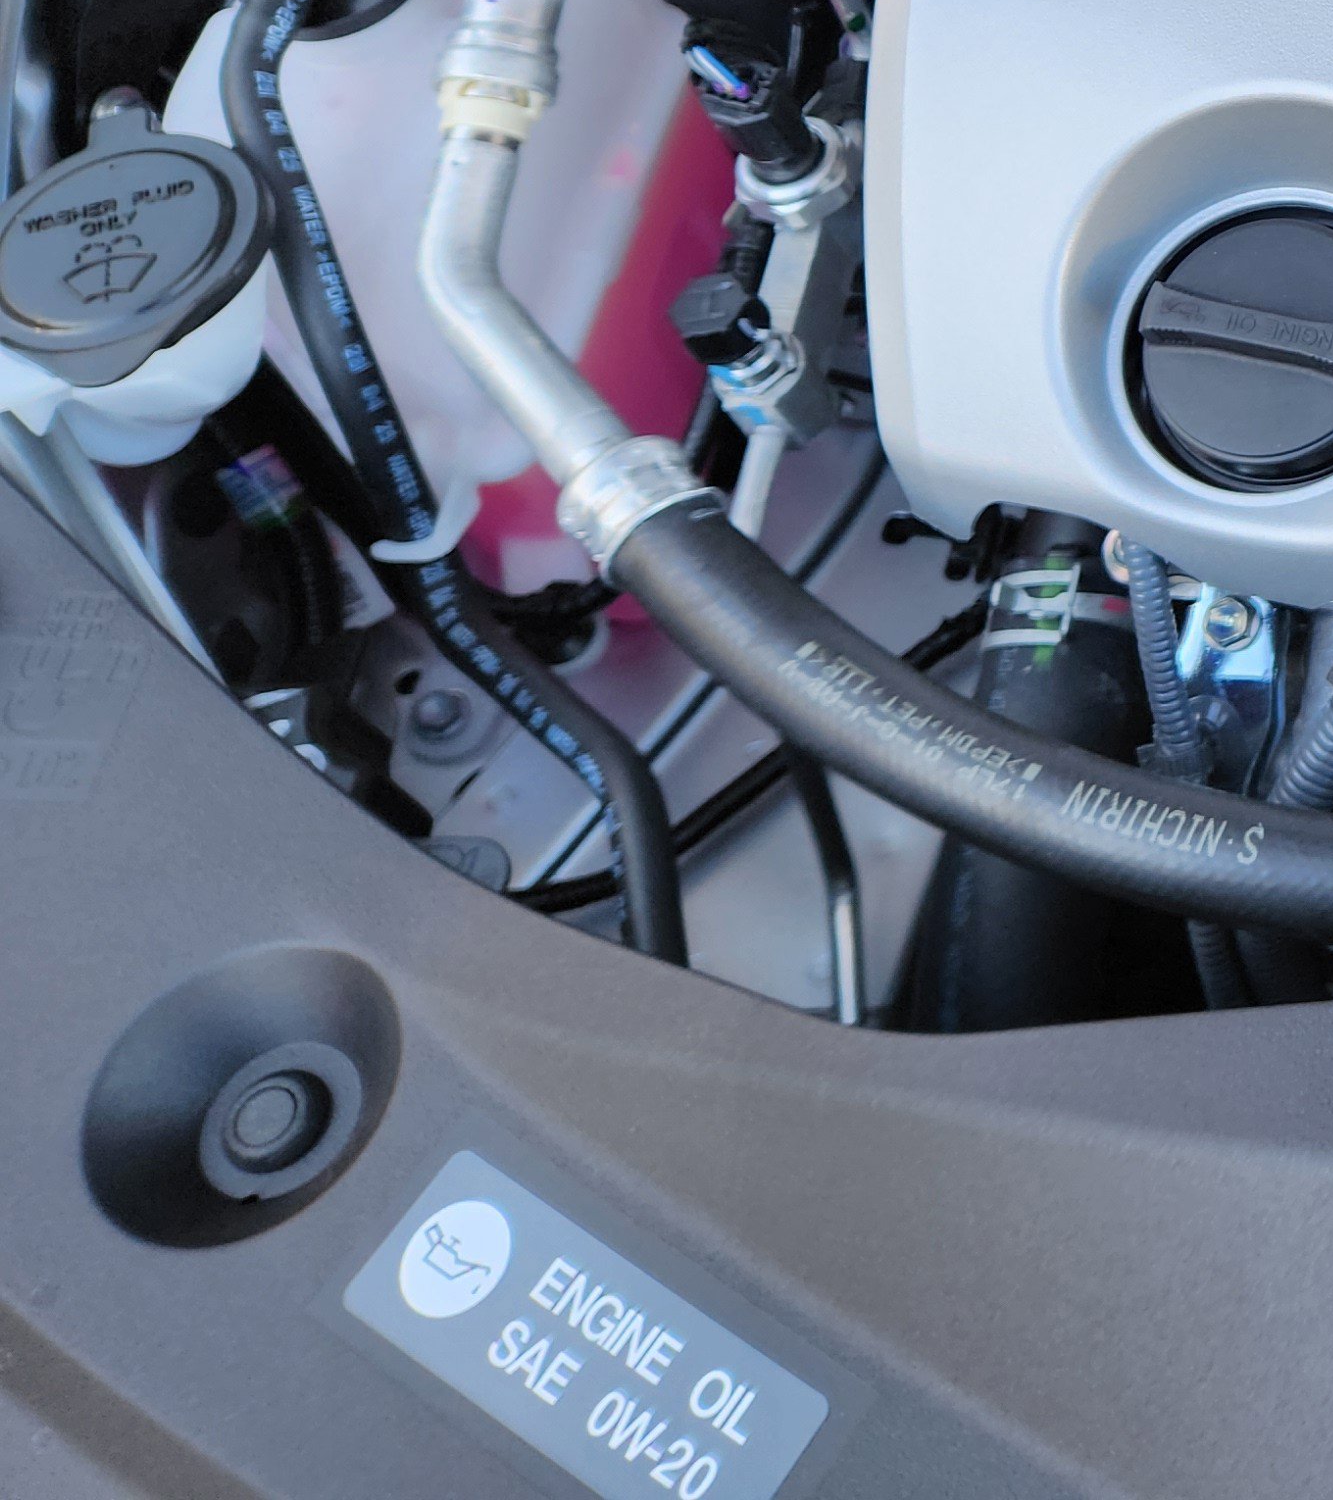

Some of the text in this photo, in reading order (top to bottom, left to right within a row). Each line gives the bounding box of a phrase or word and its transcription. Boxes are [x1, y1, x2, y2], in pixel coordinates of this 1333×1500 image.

[487, 1319, 720, 1500] SAE 0W-20
[528, 1256, 757, 1446] ENGINE OIL
